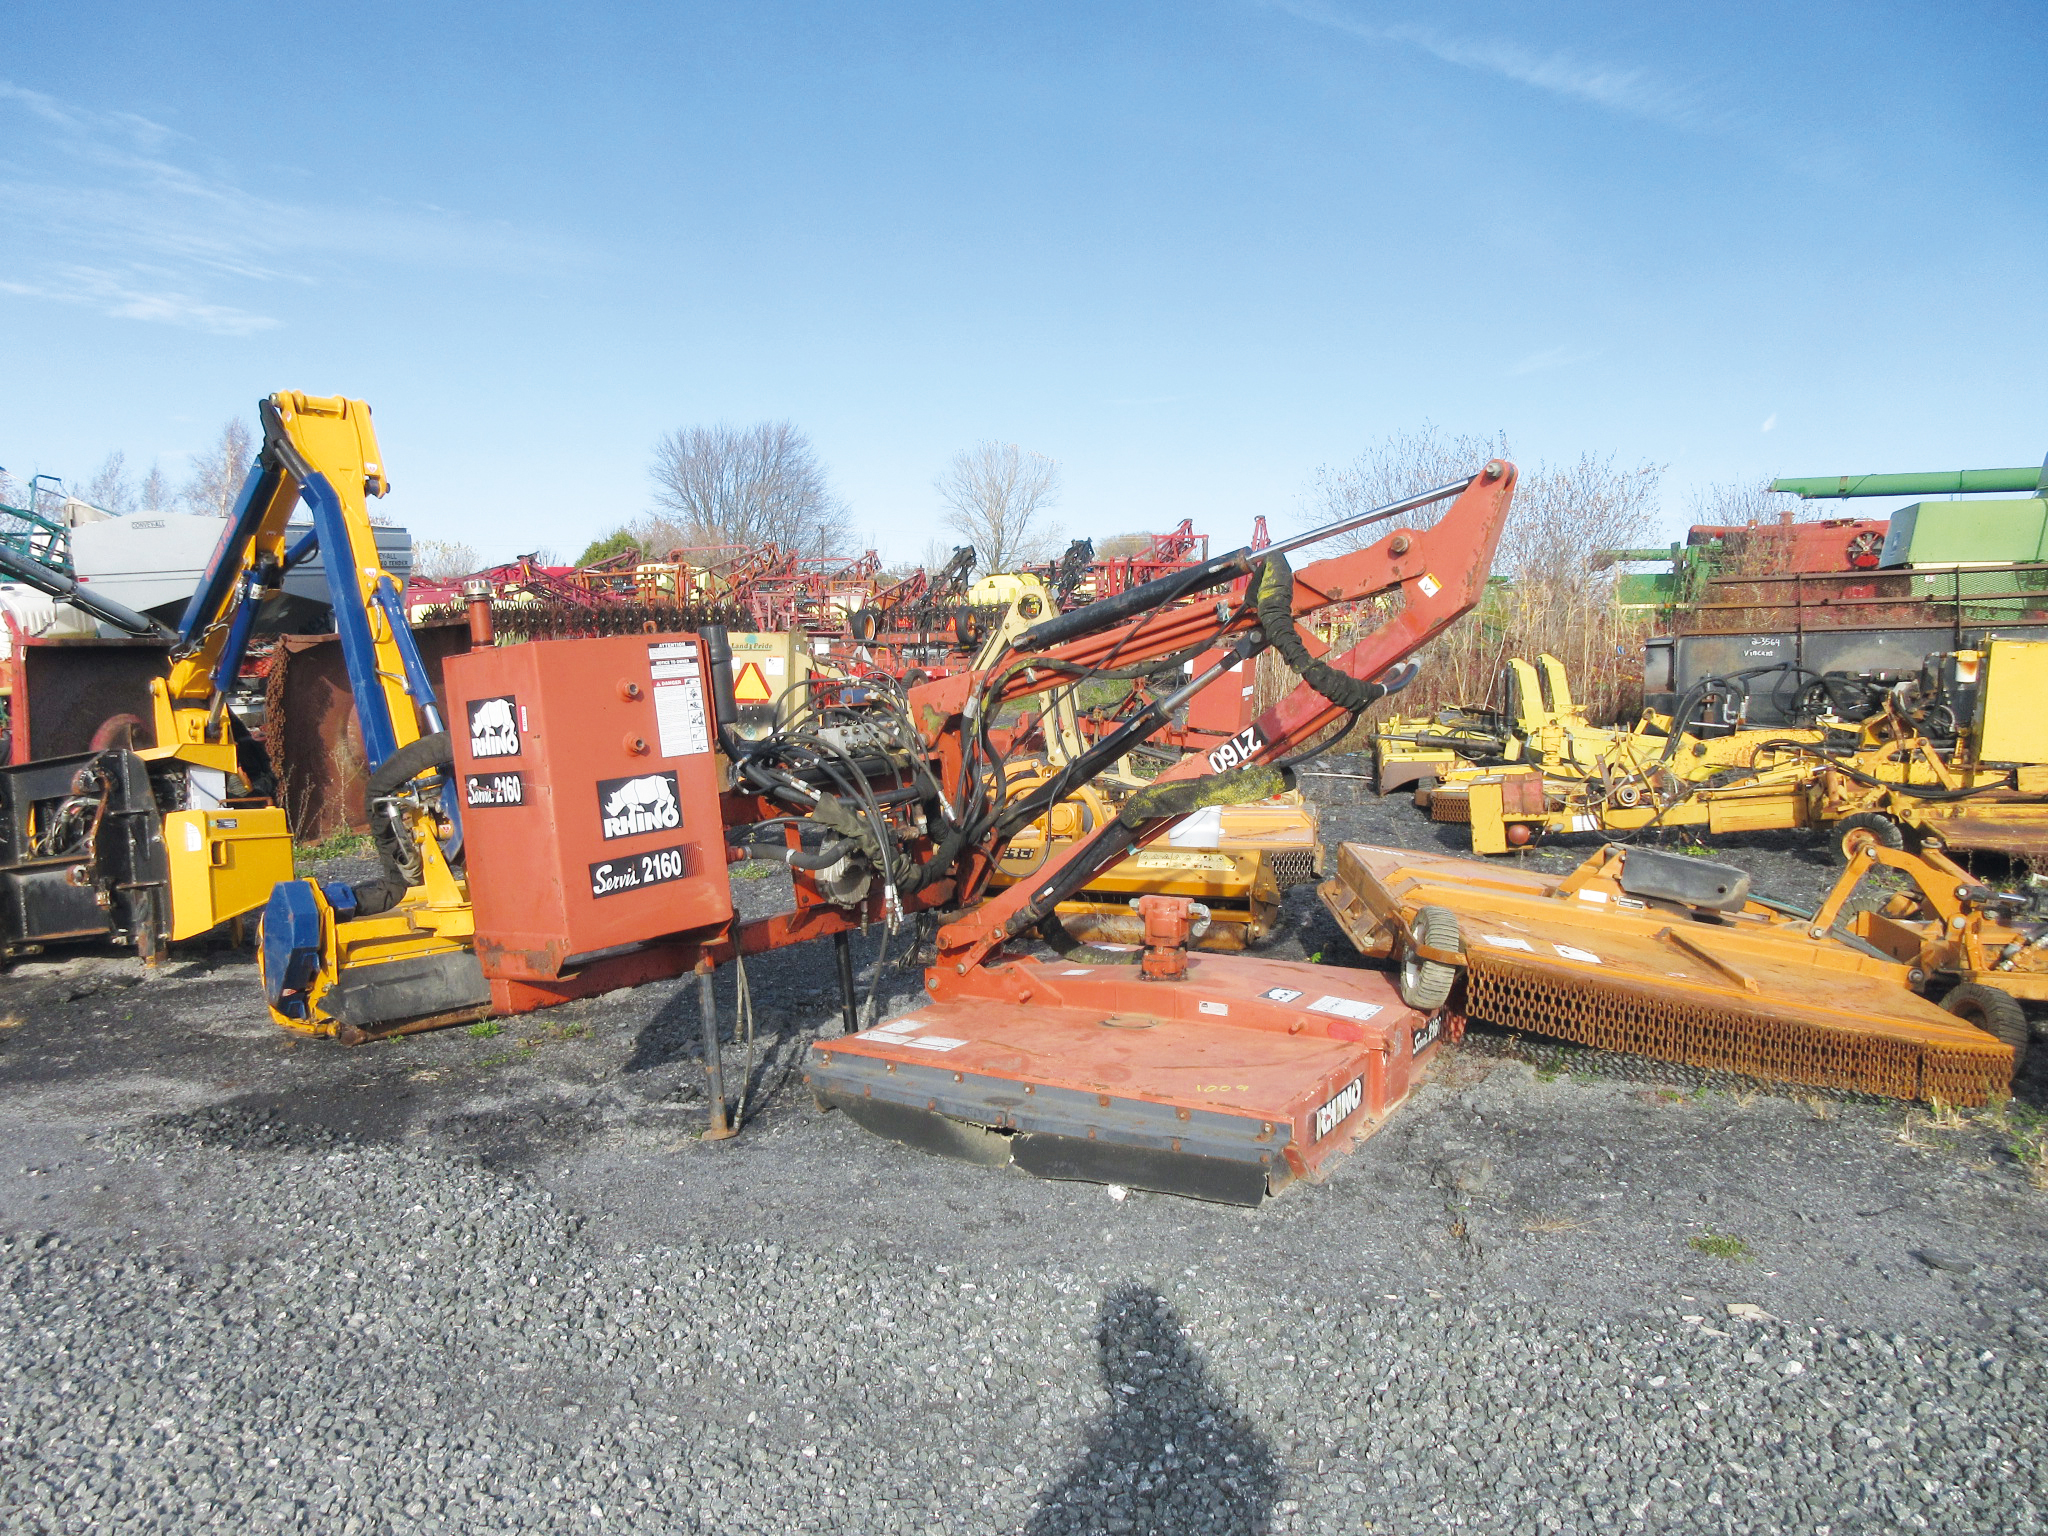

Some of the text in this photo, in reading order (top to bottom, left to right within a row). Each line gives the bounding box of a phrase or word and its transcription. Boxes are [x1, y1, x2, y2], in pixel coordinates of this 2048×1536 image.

[662, 679, 682, 687] DANGER
[471, 733, 519, 757] RHINO
[1209, 726, 1262, 774] 2160
[494, 775, 521, 803] 2160
[603, 808, 680, 838] RHINO
[593, 850, 682, 895] Servis 2160
[1316, 1078, 1362, 1141] RHINO
